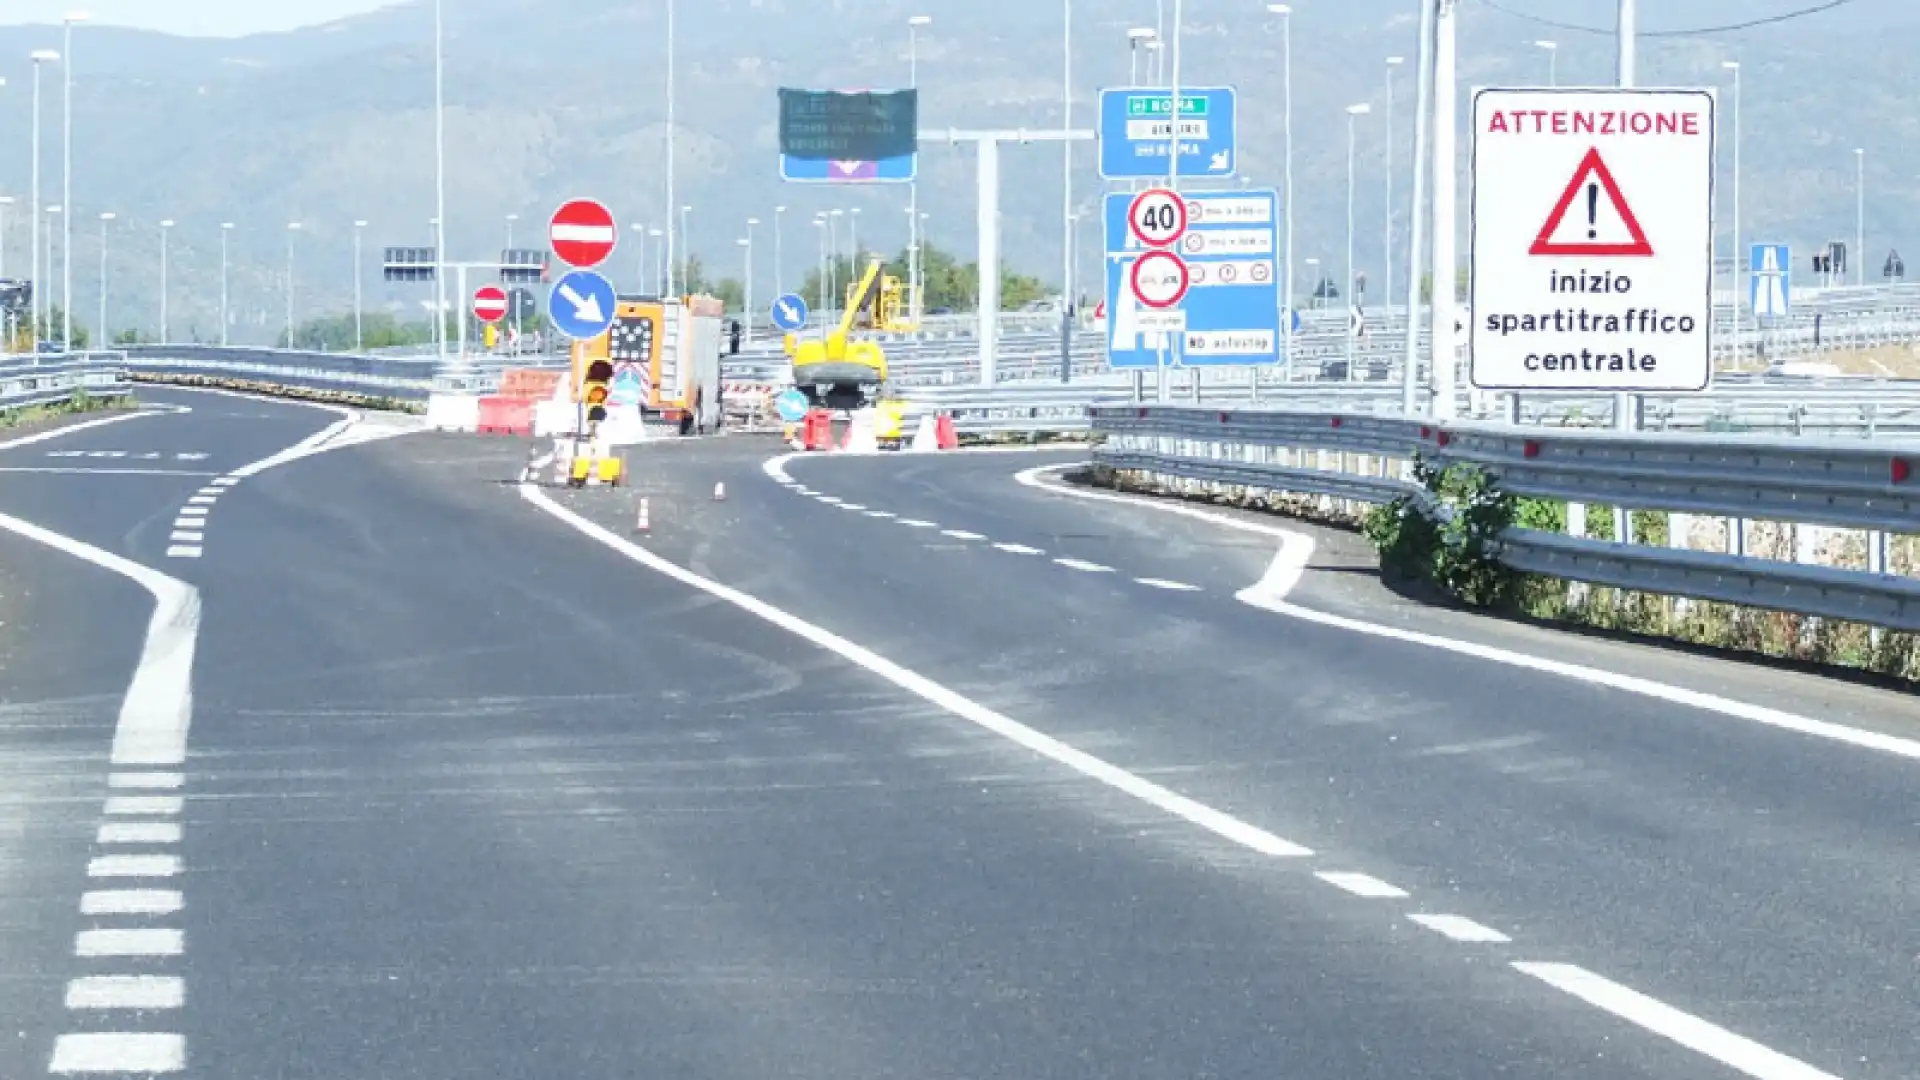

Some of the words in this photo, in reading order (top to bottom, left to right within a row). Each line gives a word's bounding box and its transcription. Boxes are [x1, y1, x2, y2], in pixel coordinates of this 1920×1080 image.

[1488, 111, 1699, 135] ATTENZIONE
[1142, 204, 1175, 232] 40
[1549, 270, 1632, 293] inizio
[1487, 308, 1695, 336] spartitraffico
[1189, 335, 1205, 348] NO
[1523, 348, 1657, 372] centrale
